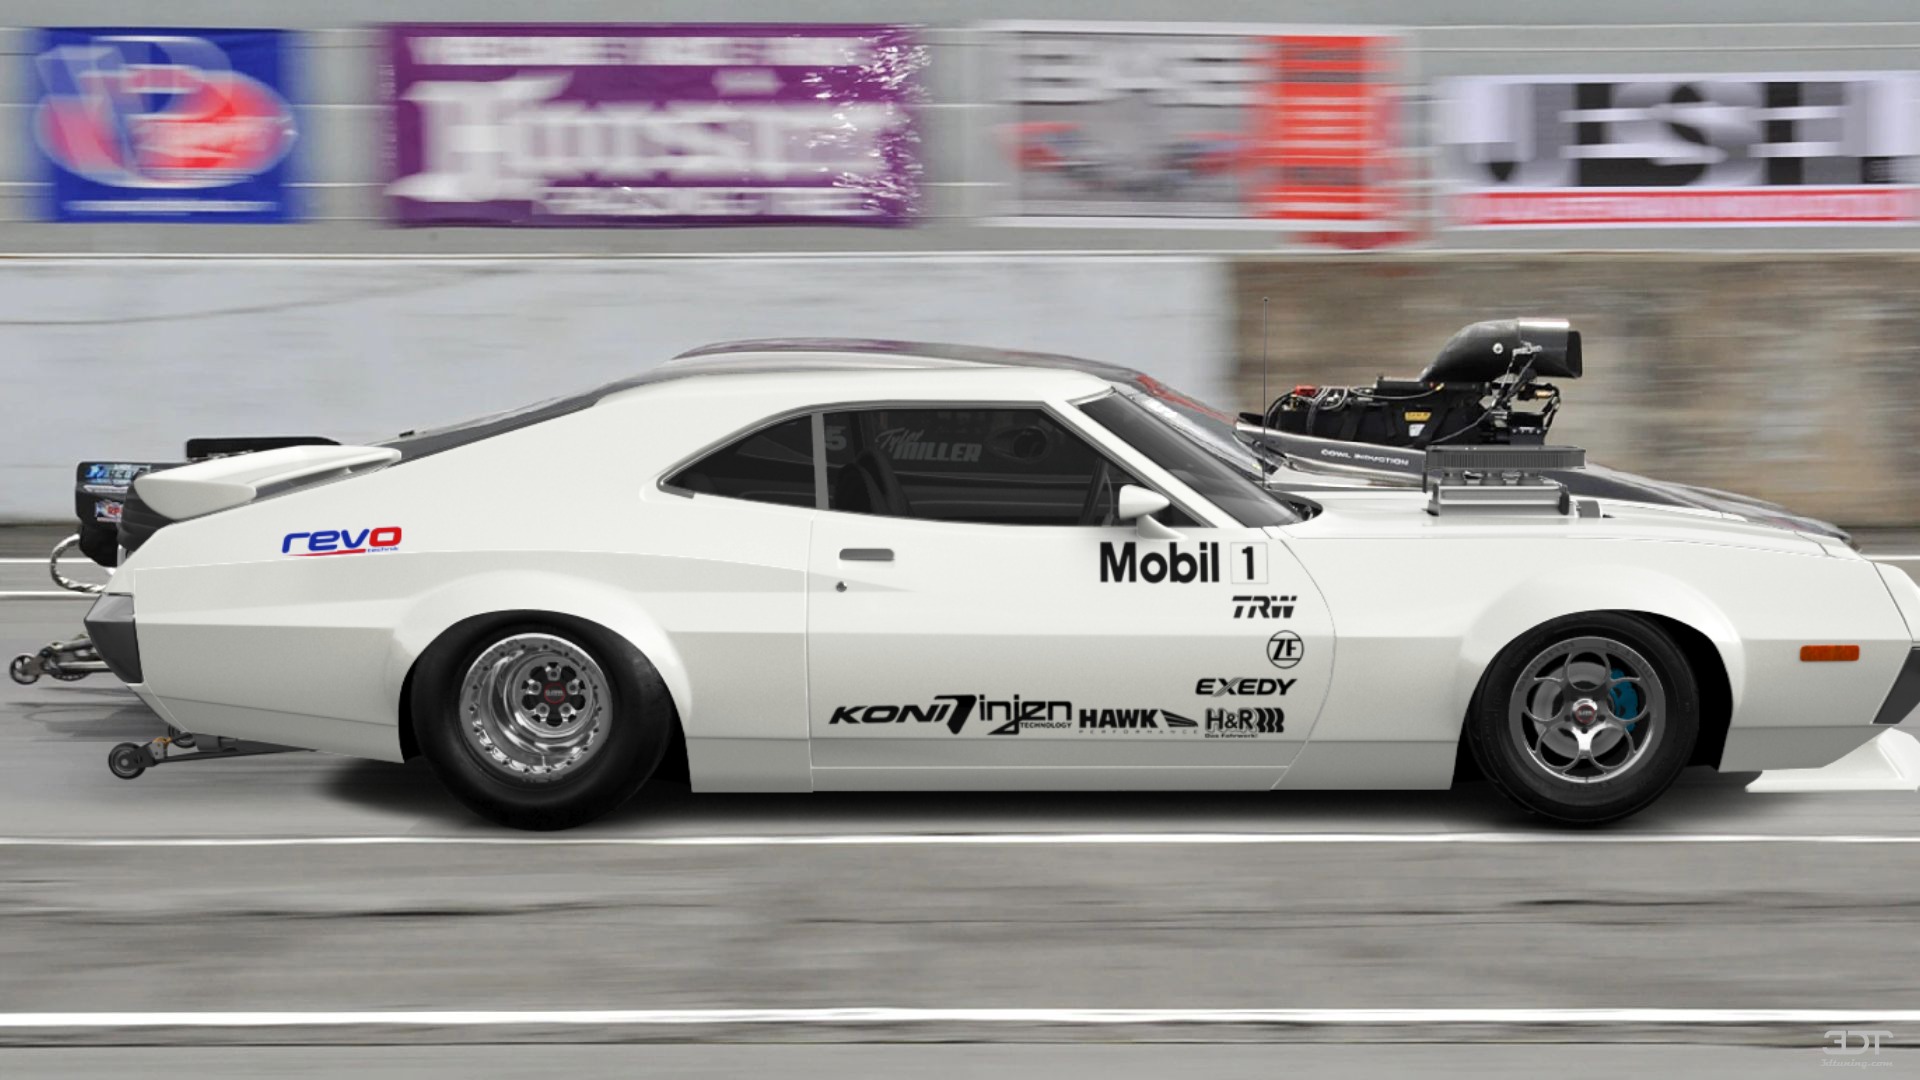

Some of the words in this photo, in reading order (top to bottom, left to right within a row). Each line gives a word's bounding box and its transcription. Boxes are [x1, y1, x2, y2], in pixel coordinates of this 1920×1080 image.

[892, 441, 983, 463] MILLER
[1321, 448, 1352, 459] COWL
[1354, 452, 1410, 466] INDUCTION
[282, 526, 402, 554] revo
[1100, 541, 1219, 583] Mobil
[1241, 546, 1254, 580] 1
[1232, 596, 1297, 618] TRW
[1269, 636, 1301, 662] ZF
[1195, 677, 1297, 697] EXEDY
[828, 704, 950, 724] KONI
[979, 694, 1072, 735] injen
[1079, 709, 1158, 728] HAWK
[1205, 708, 1255, 732] H&R
